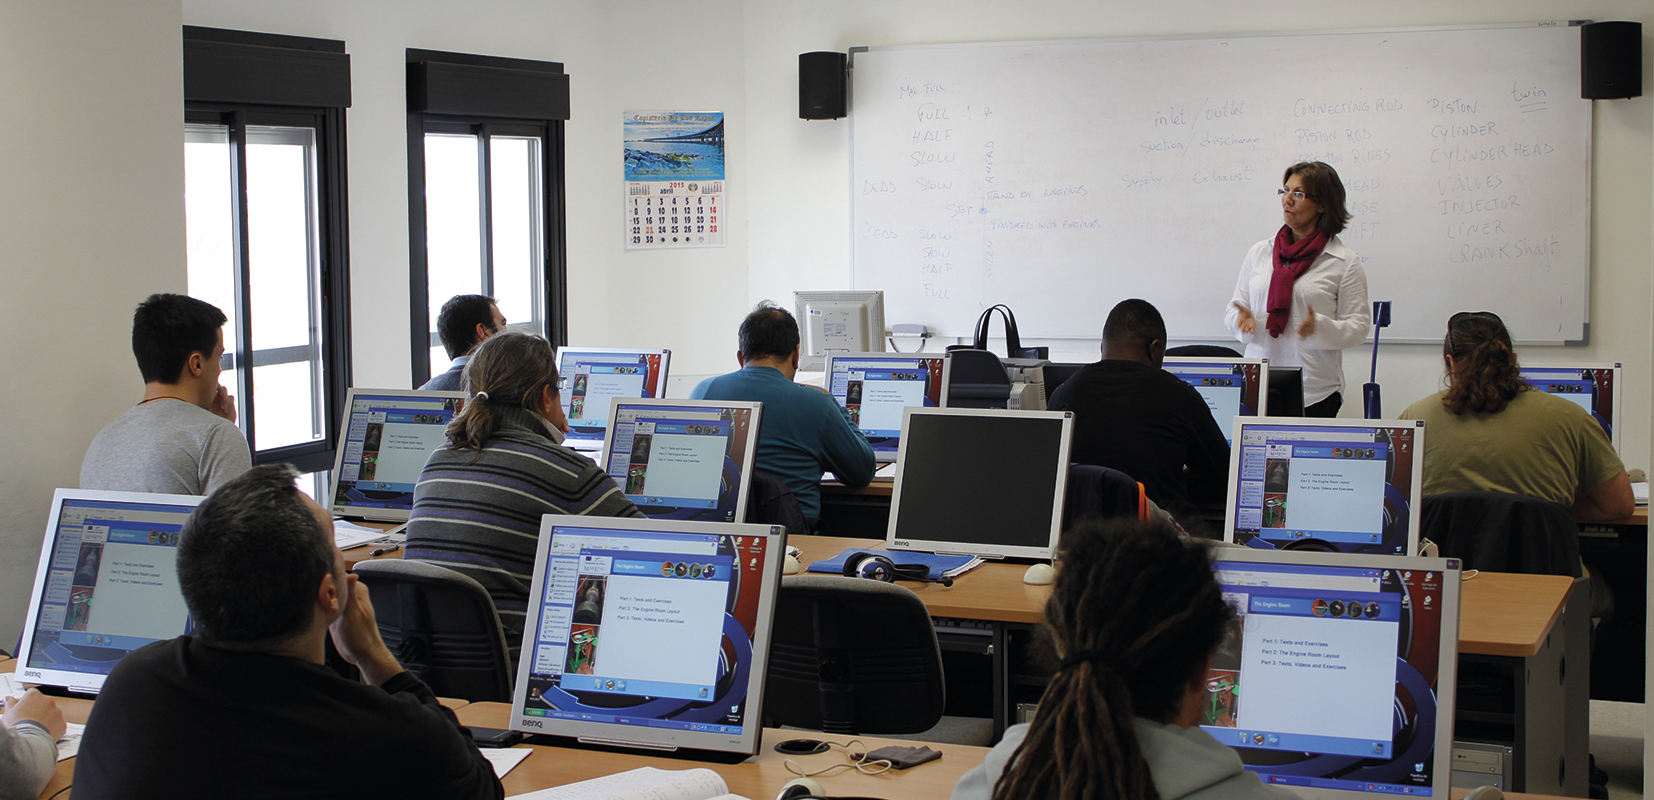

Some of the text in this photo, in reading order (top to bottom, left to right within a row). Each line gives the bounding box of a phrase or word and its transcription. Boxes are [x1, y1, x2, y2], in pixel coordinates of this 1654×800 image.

[1510, 81, 1547, 102] twin
[917, 102, 950, 122] FULL
[1155, 106, 1186, 127] inlet
[1205, 99, 1246, 120] outlet
[1293, 97, 1403, 118] CONNECTING ROD
[912, 129, 953, 144] HALF
[1200, 132, 1260, 151] discharge
[1345, 127, 1371, 143] ROD
[1351, 148, 1392, 165] RINGS
[1514, 142, 1554, 157] HEAD
[862, 180, 896, 196] DEAD
[986, 190, 1015, 200] STAND
[1044, 184, 1088, 197] ENGINES
[685, 197, 689, 205] 5
[698, 197, 702, 205] 6
[1438, 195, 1520, 215] INJECTOR
[634, 207, 638, 215] 8
[647, 207, 651, 215] 9
[658, 207, 665, 215] 10
[671, 207, 677, 215] 11
[710, 206, 717, 214] 14
[633, 217, 640, 225] 15
[646, 217, 653, 225] 16
[671, 216, 678, 224] 18
[684, 216, 691, 224] 19
[696, 216, 704, 224] 20
[991, 219, 1033, 230] FINISHED
[1063, 219, 1101, 229] ENGINES
[646, 226, 654, 234] 23
[658, 226, 666, 234] 24
[697, 225, 704, 233] 27
[710, 225, 718, 233] 28
[863, 222, 898, 240] DEAD
[1447, 219, 1505, 239] LINER
[633, 236, 641, 244] 29
[922, 263, 953, 275] HALF
[923, 283, 950, 300] FULL
[24, 670, 42, 679] BenQ
[522, 719, 543, 729] BenQ
